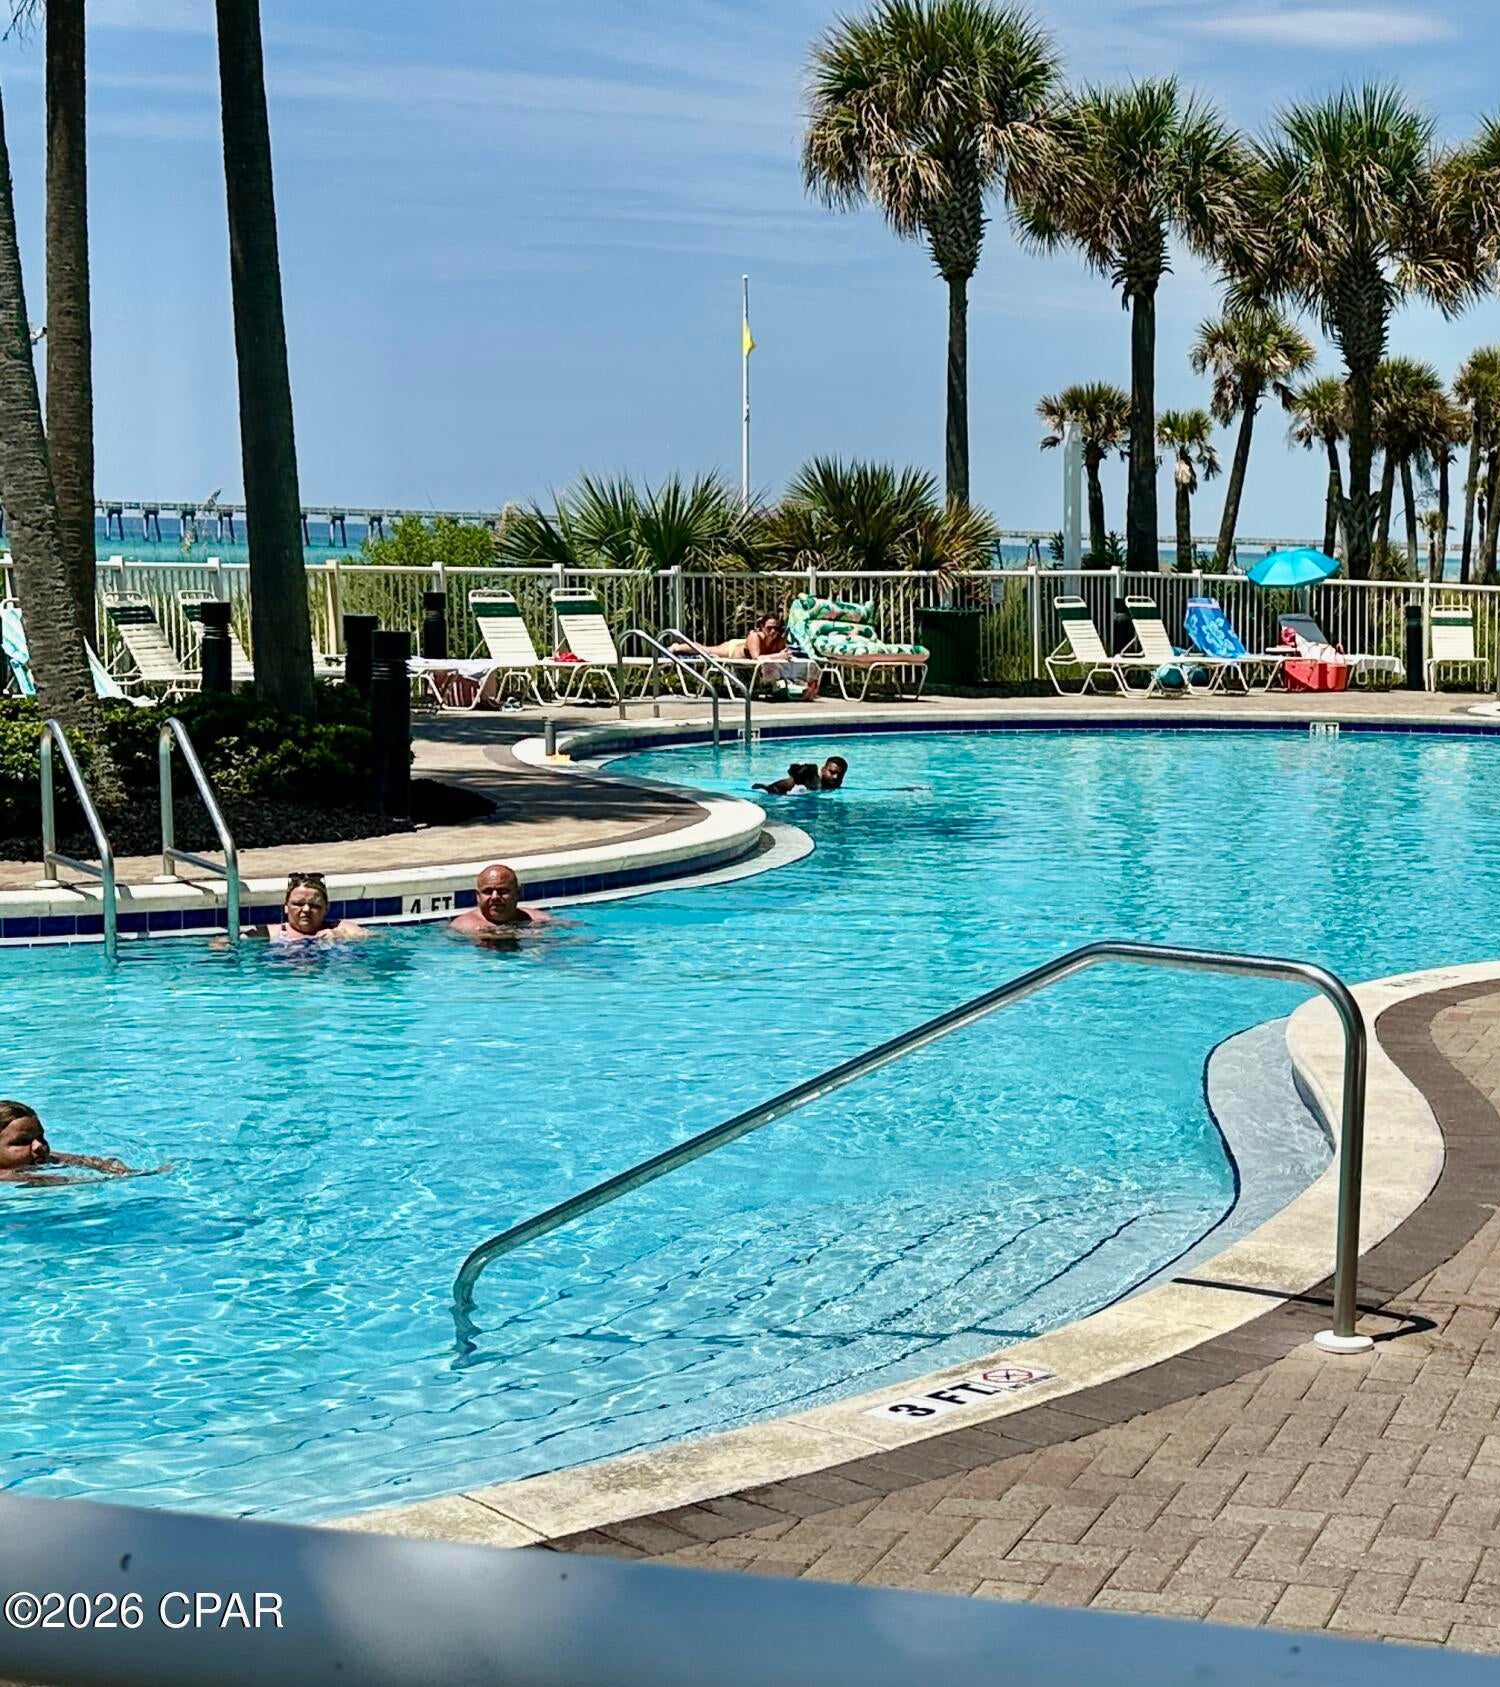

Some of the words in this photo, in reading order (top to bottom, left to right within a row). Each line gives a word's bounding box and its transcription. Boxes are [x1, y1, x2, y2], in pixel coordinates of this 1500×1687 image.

[431, 896, 452, 911] FT
[888, 1404, 936, 1417] 3
[925, 1383, 1001, 1405] FT
